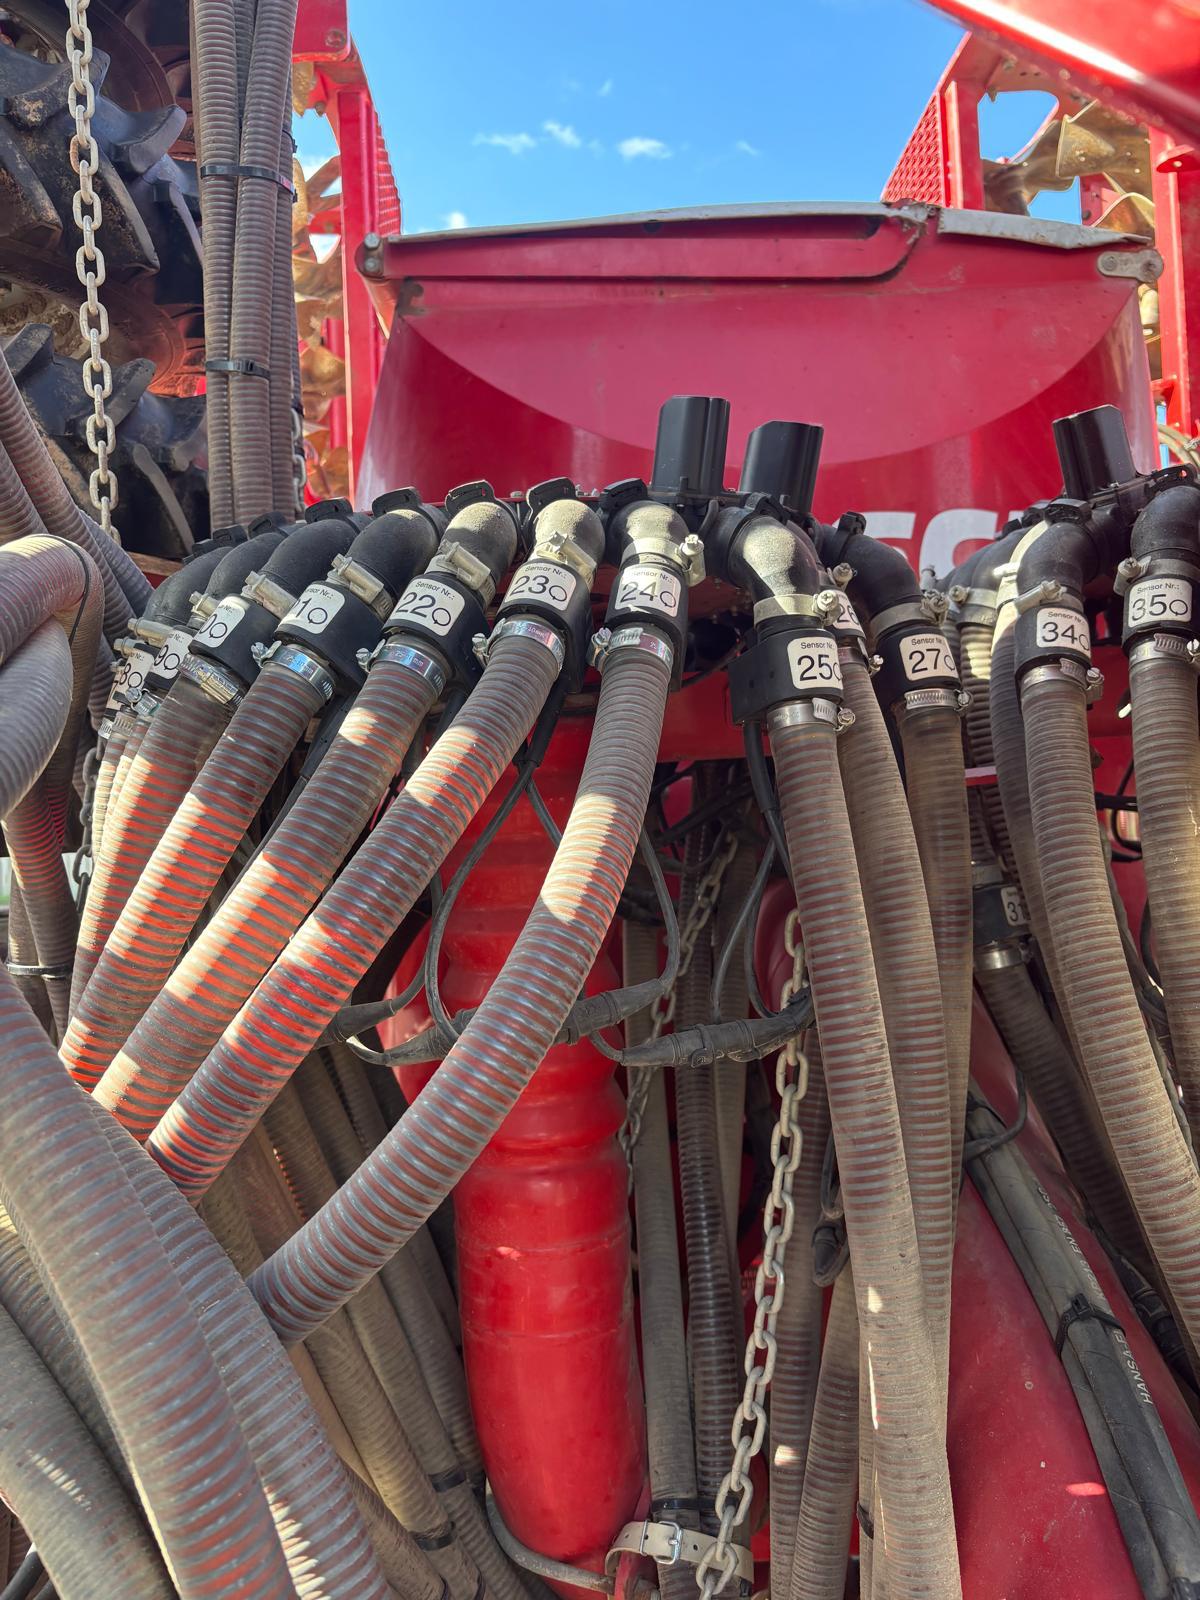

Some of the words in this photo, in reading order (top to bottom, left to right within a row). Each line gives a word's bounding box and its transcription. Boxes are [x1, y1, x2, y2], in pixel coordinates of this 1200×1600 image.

[524, 564, 552, 573] Sensor
[415, 580, 442, 593] Sensor
[1136, 584, 1164, 594] Sensor
[1047, 611, 1074, 620] Sensor
[800, 641, 826, 649] Sensor
[910, 637, 936, 646] Sensor
